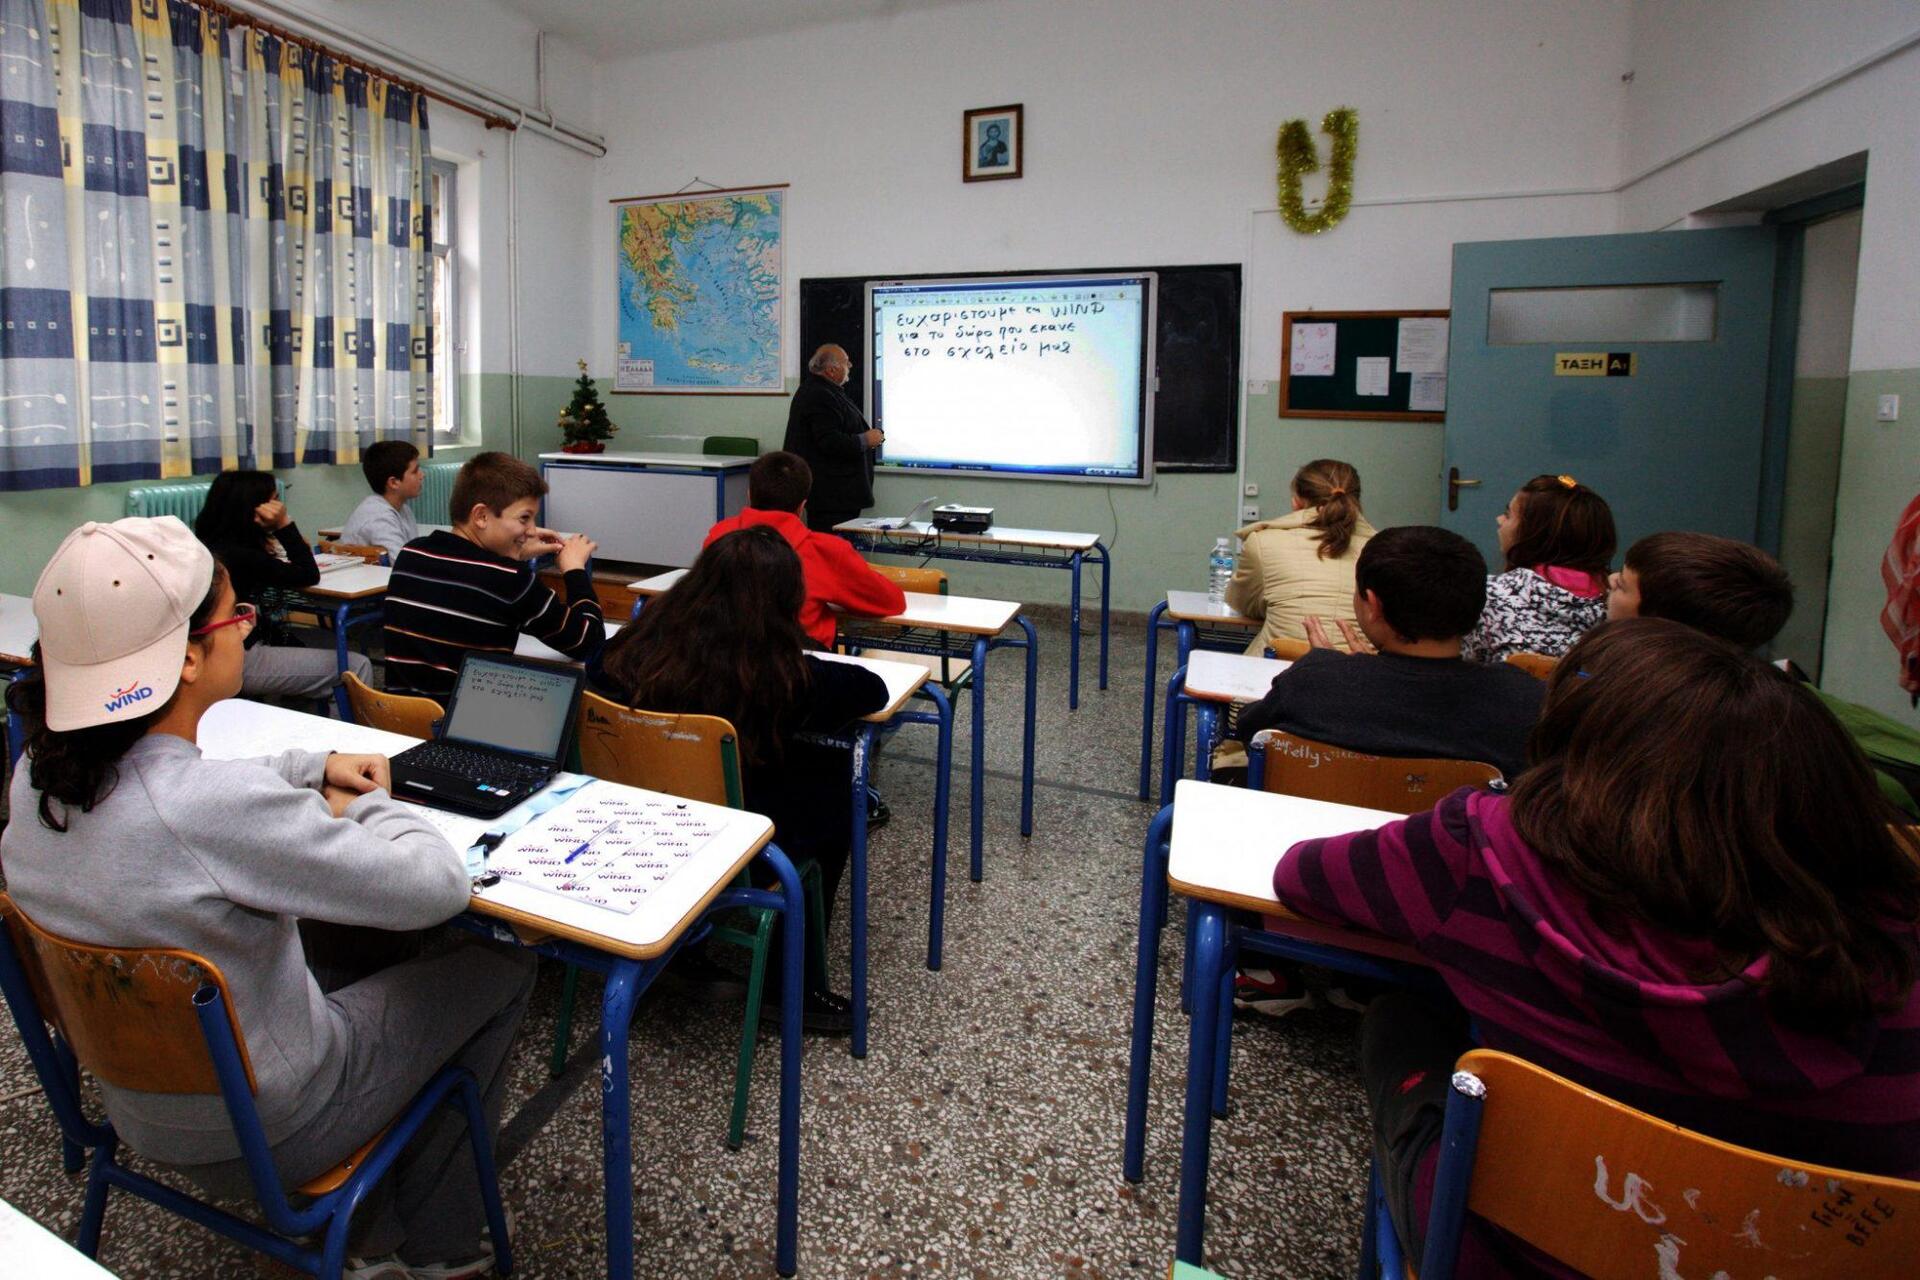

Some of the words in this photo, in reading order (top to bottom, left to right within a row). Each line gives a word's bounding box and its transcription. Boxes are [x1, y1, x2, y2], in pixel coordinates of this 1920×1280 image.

[1051, 301, 1105, 317] WIND
[898, 332, 918, 343] για
[1561, 359, 1603, 370] ΤΑΞΗ
[105, 686, 153, 712] WIND
[529, 857, 561, 865] WIND
[636, 861, 669, 869] WIND
[543, 870, 576, 878] WIND
[598, 871, 631, 880] WIND
[613, 884, 647, 893] WIND
